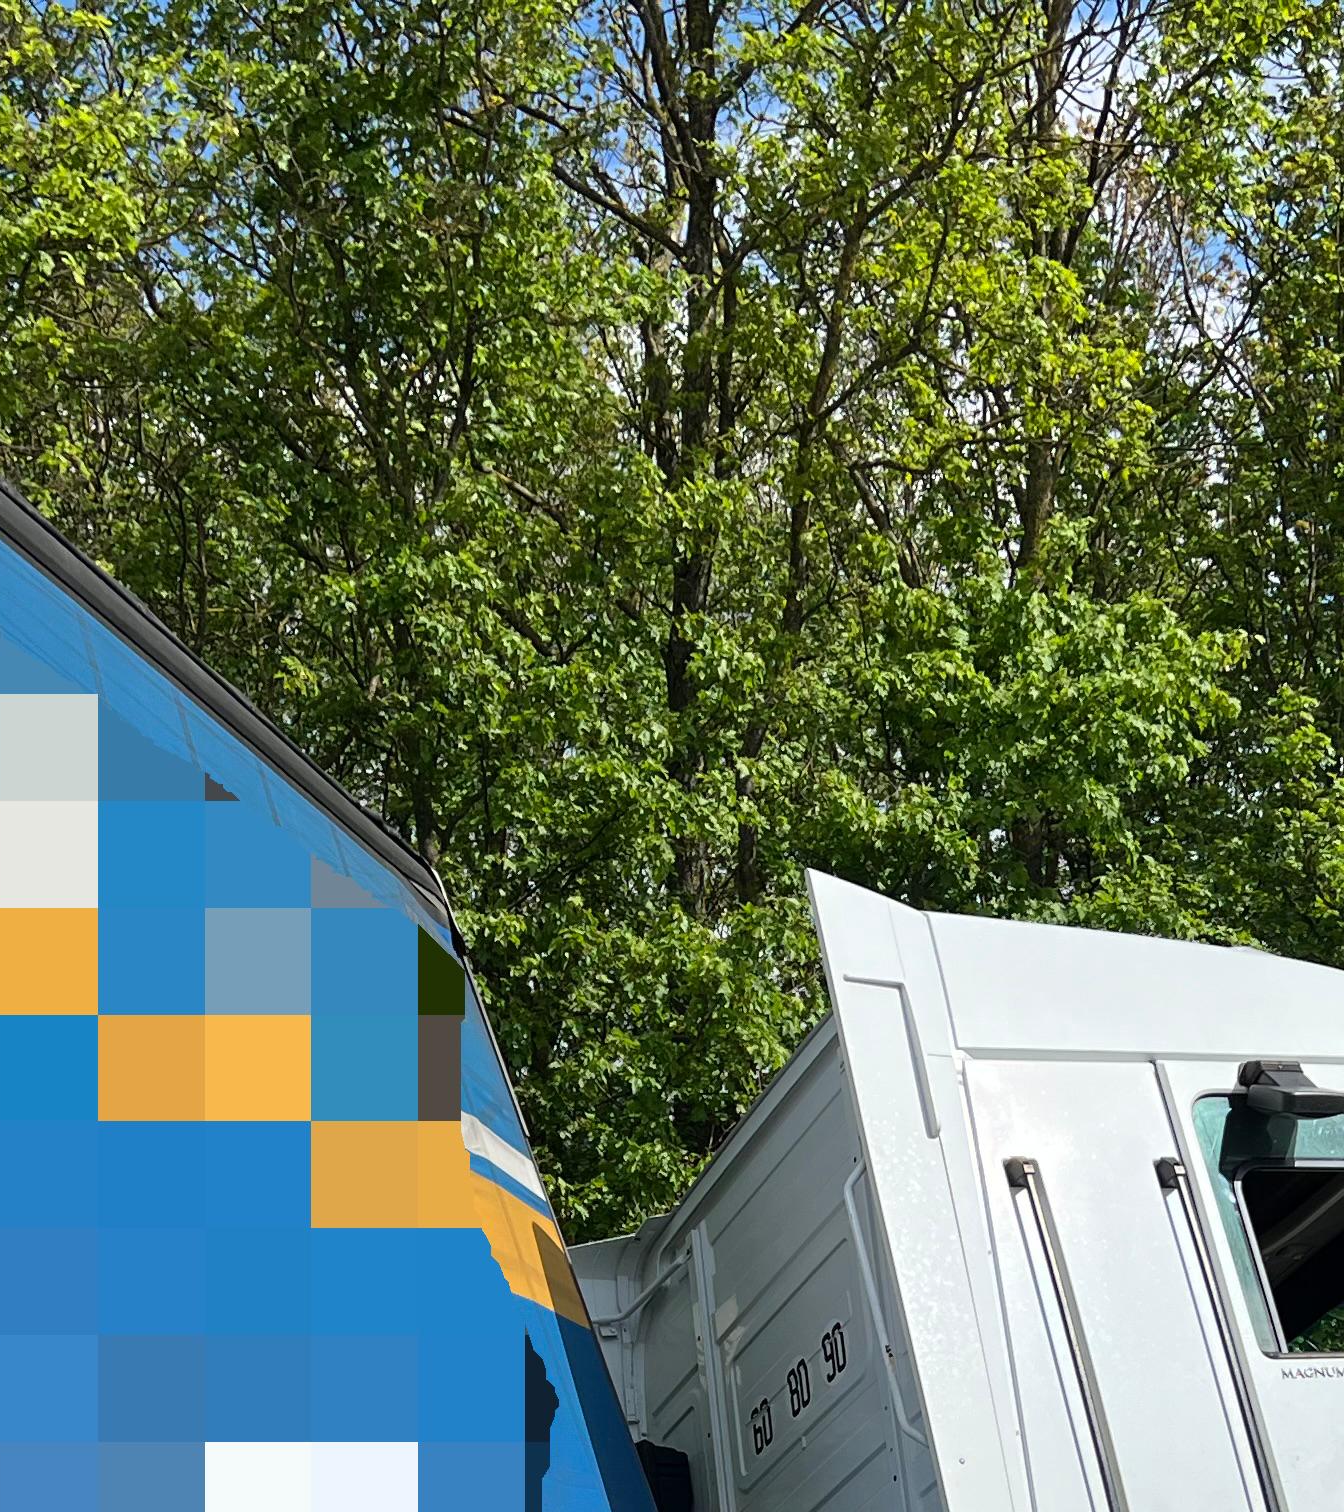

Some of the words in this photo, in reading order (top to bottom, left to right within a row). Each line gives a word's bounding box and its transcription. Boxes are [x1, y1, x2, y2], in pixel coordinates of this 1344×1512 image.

[751, 1398, 772, 1455] 60
[787, 1358, 810, 1417] 80
[821, 1322, 847, 1382] 90
